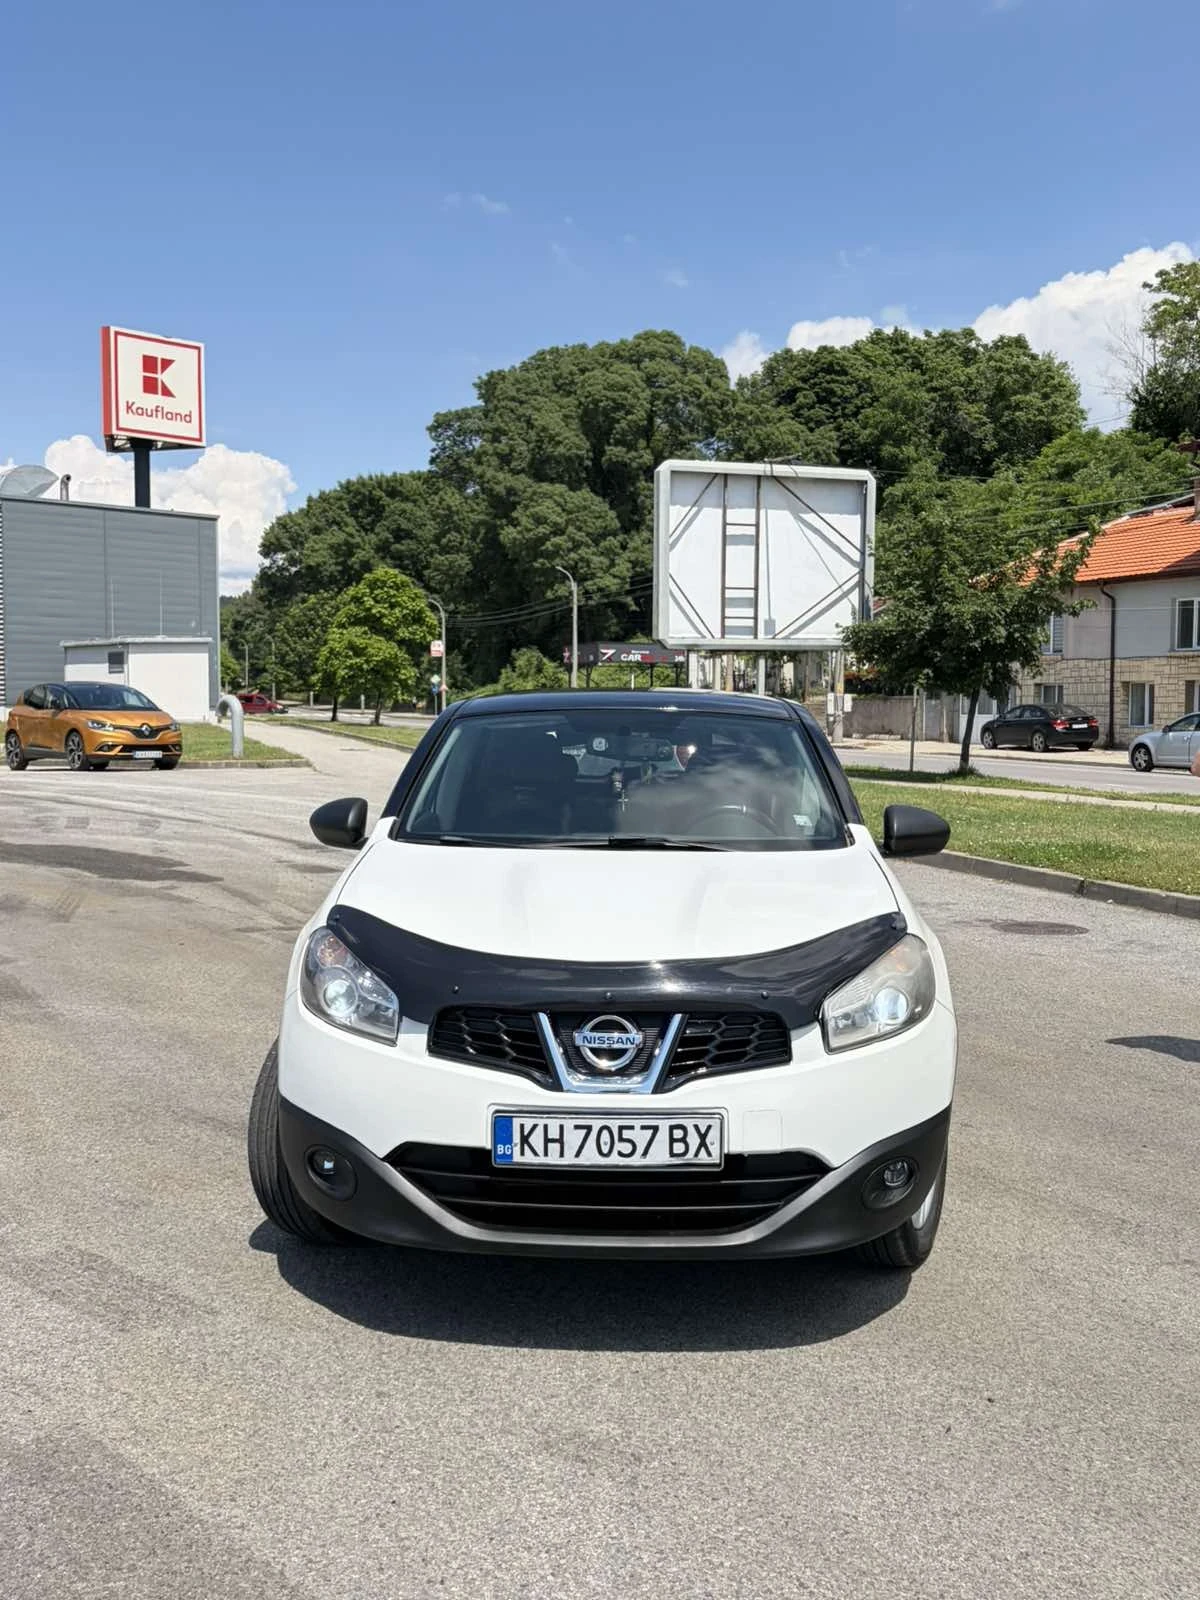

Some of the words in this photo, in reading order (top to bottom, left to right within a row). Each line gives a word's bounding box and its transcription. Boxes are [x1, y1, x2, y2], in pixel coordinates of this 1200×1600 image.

[125, 400, 193, 424] Kaufland
[582, 1035, 635, 1045] NISSAN
[497, 1144, 512, 1155] BG
